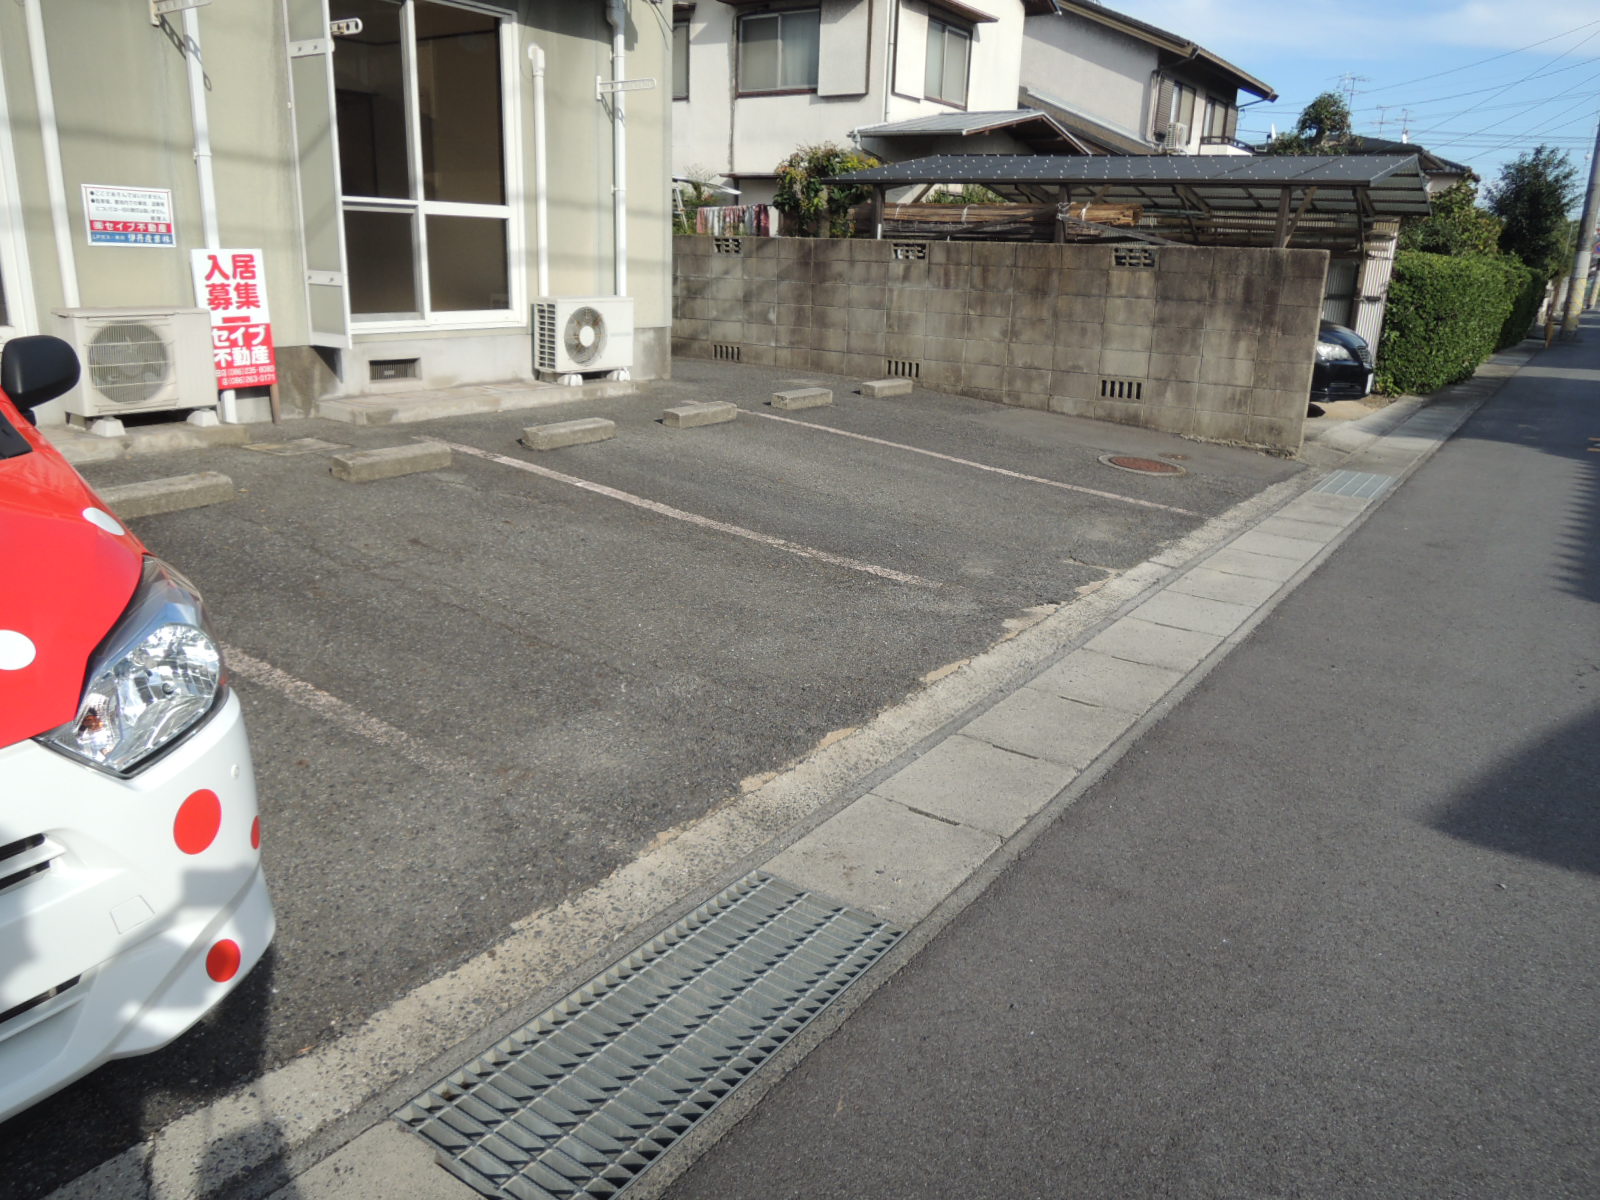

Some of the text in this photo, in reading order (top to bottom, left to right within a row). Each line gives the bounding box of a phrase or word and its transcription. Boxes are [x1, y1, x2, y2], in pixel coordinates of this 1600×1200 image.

[204, 254, 257, 281] 入居
[204, 282, 261, 311] 募集
[213, 345, 271, 368] 不動産
